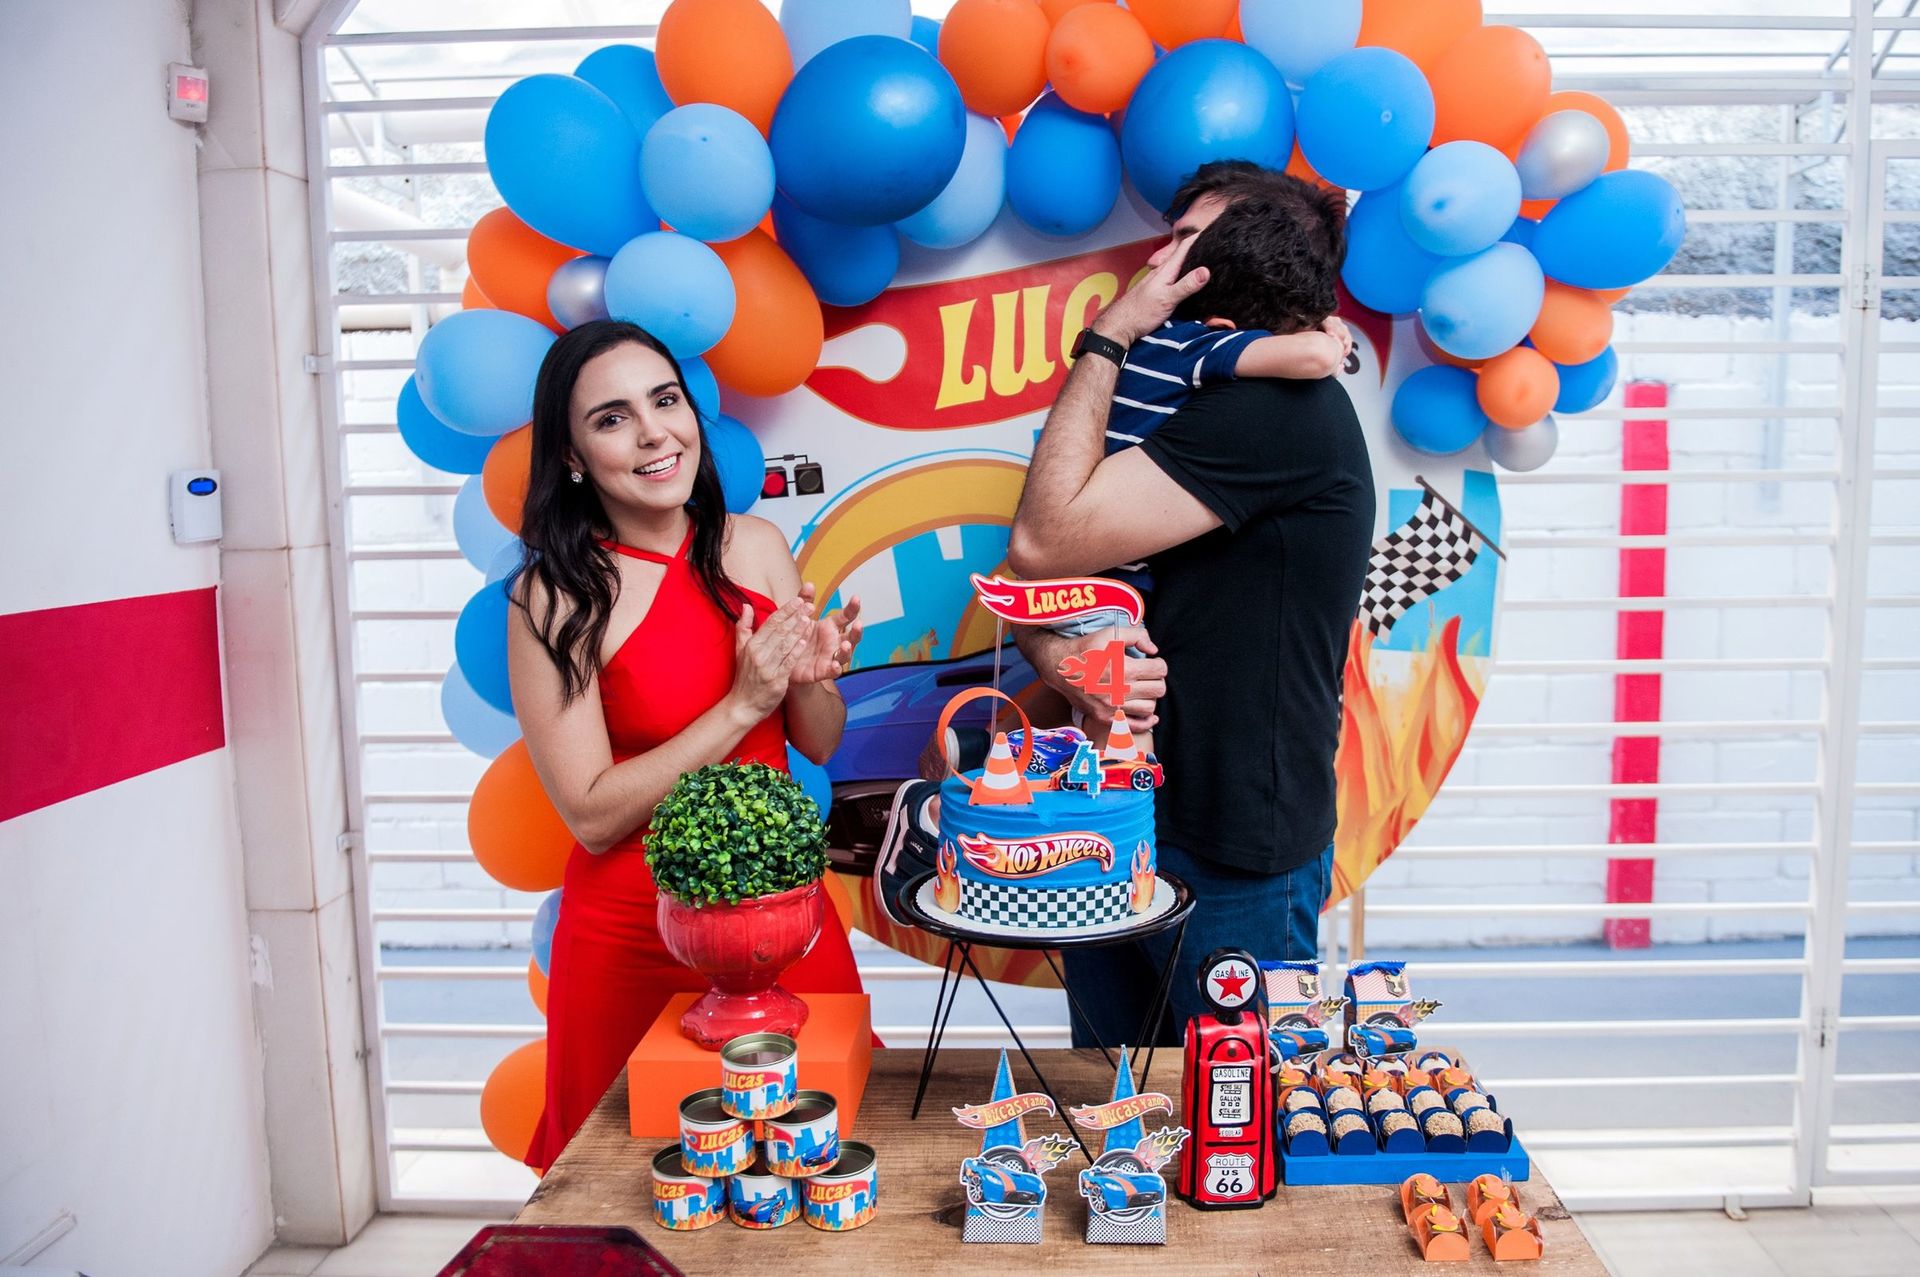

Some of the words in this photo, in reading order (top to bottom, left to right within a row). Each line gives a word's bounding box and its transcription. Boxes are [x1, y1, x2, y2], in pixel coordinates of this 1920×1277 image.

[1084, 640, 1131, 706] 4
[1067, 740, 1105, 796] 4
[1214, 1068, 1249, 1078] GASOLINE
[1215, 1157, 1246, 1167] ROUTE
[1215, 1177, 1243, 1194] 66
